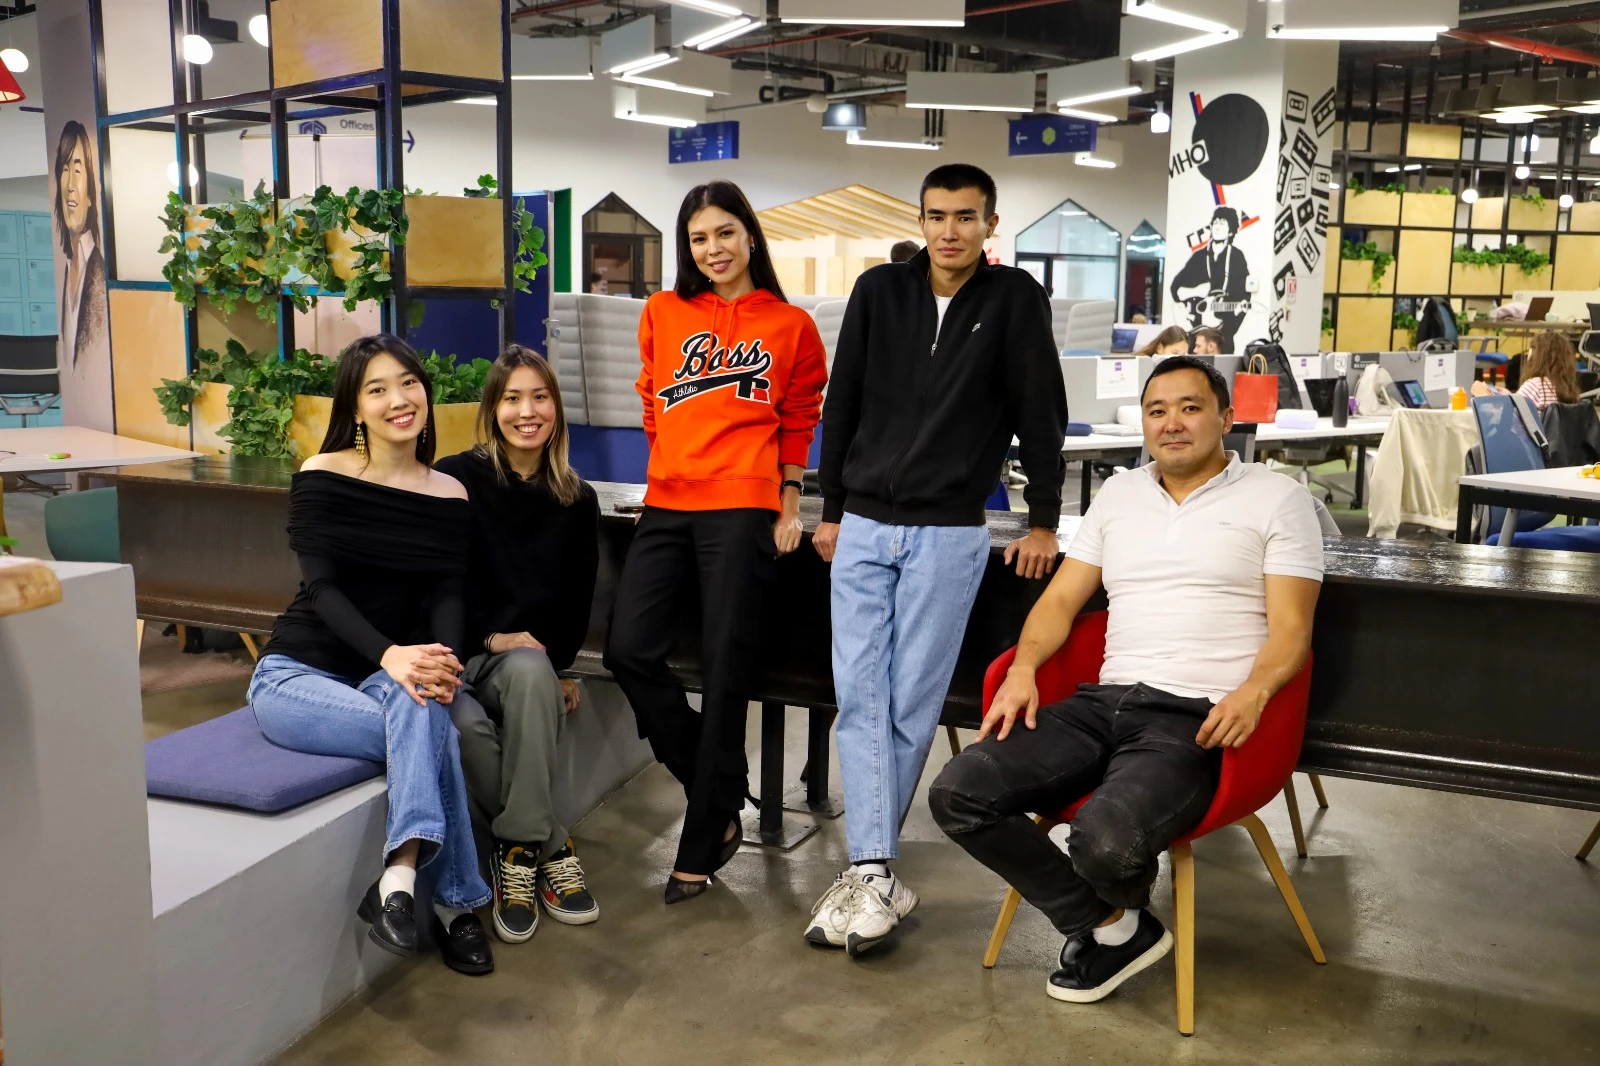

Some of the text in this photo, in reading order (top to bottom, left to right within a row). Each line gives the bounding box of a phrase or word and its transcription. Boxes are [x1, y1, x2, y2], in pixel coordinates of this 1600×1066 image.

[340, 119, 374, 131] Offices
[673, 331, 770, 381] Boss
[672, 385, 698, 400] Athletic
